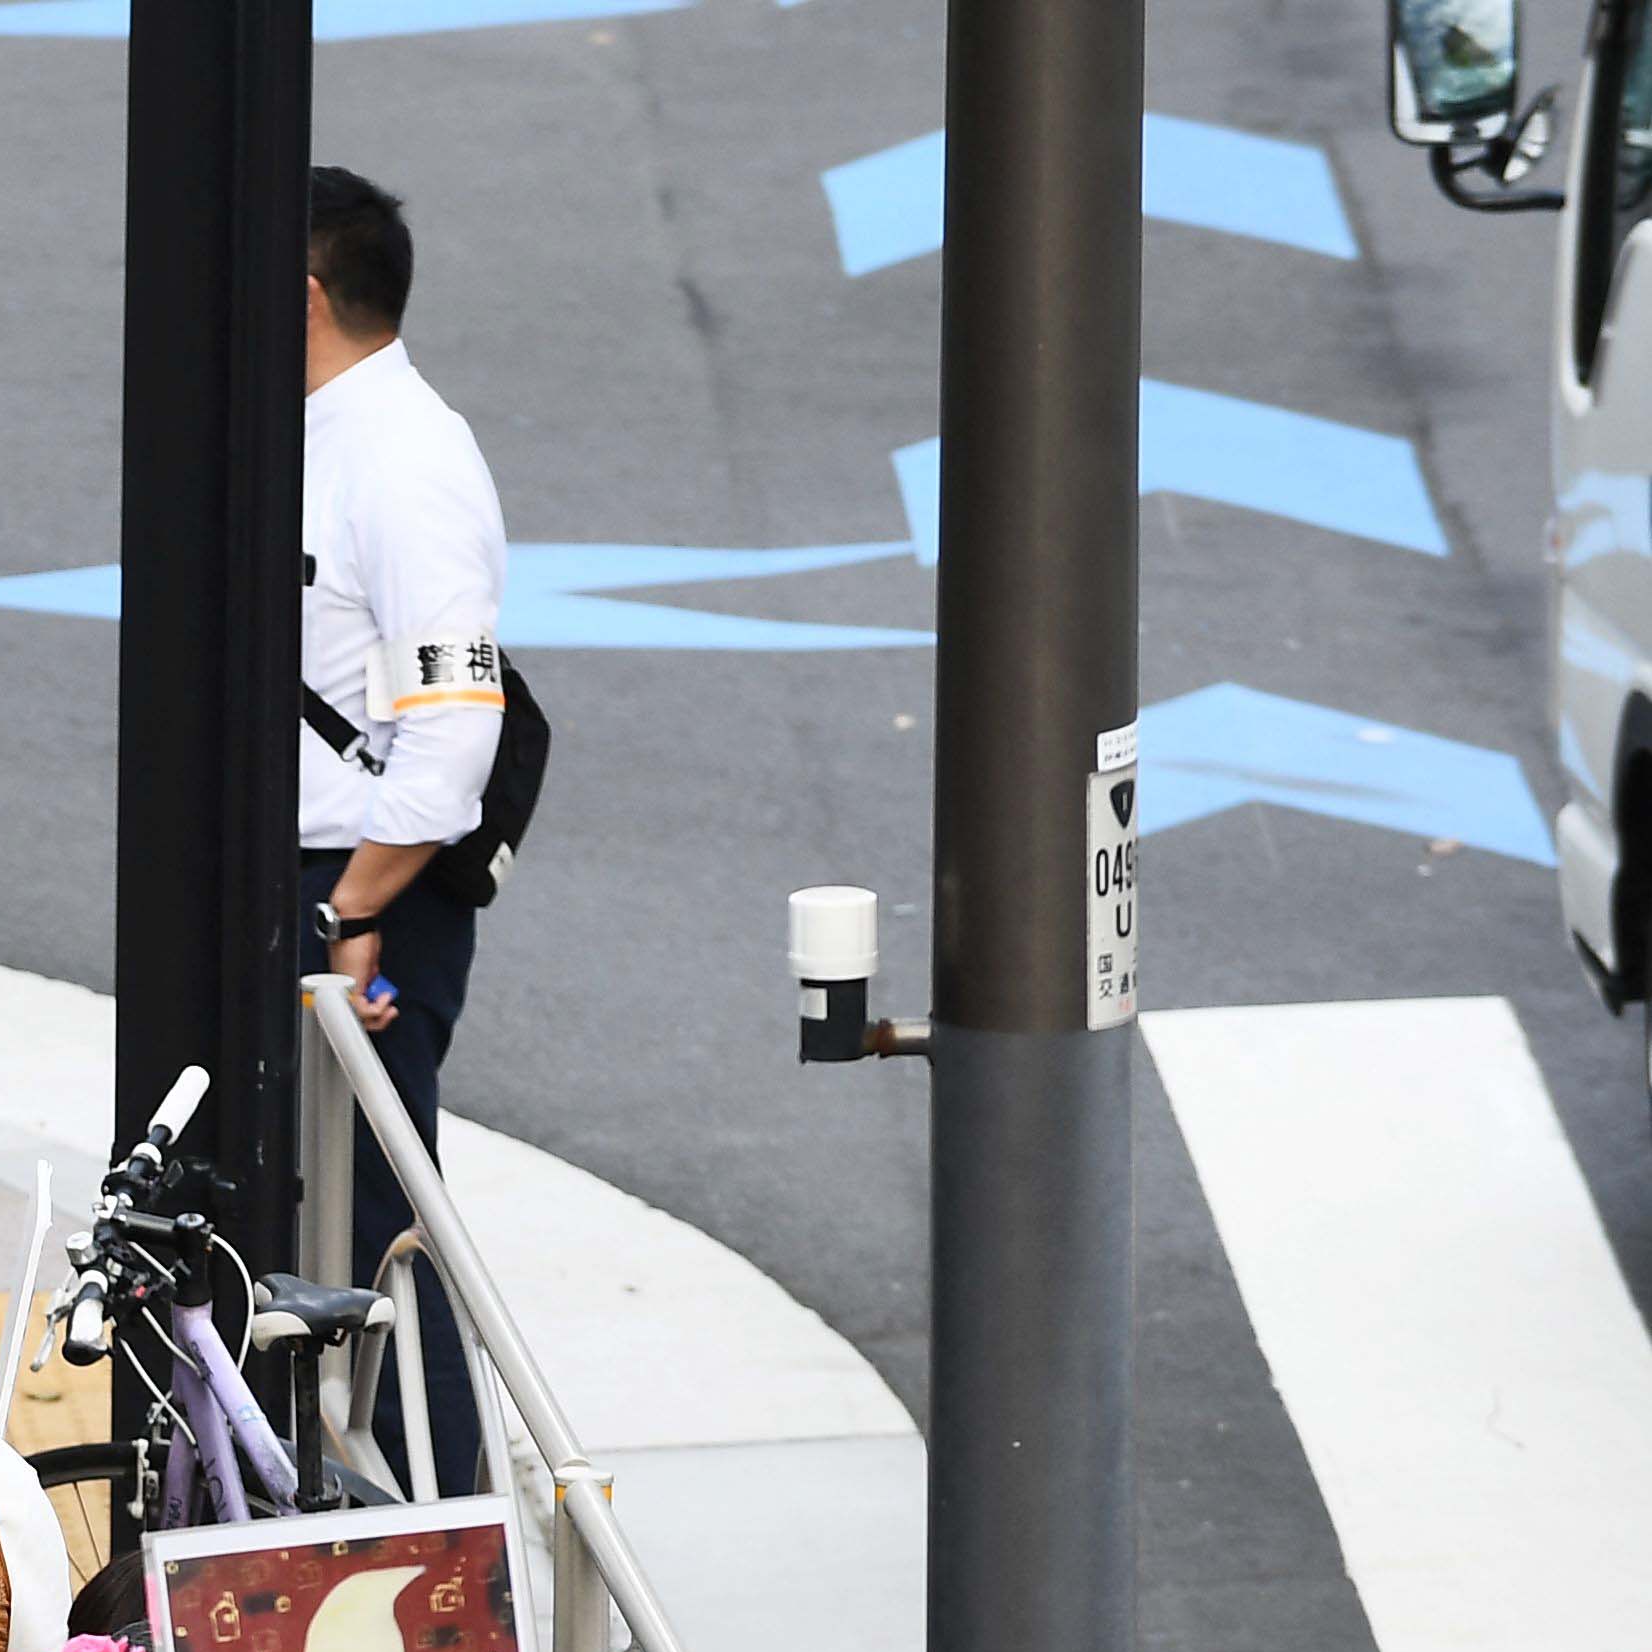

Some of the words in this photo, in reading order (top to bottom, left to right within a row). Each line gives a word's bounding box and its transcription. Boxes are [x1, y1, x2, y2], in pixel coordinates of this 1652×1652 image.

[1096, 838, 1138, 898] 049
[1115, 900, 1133, 939] U
[1098, 971, 1138, 1001] 交通
